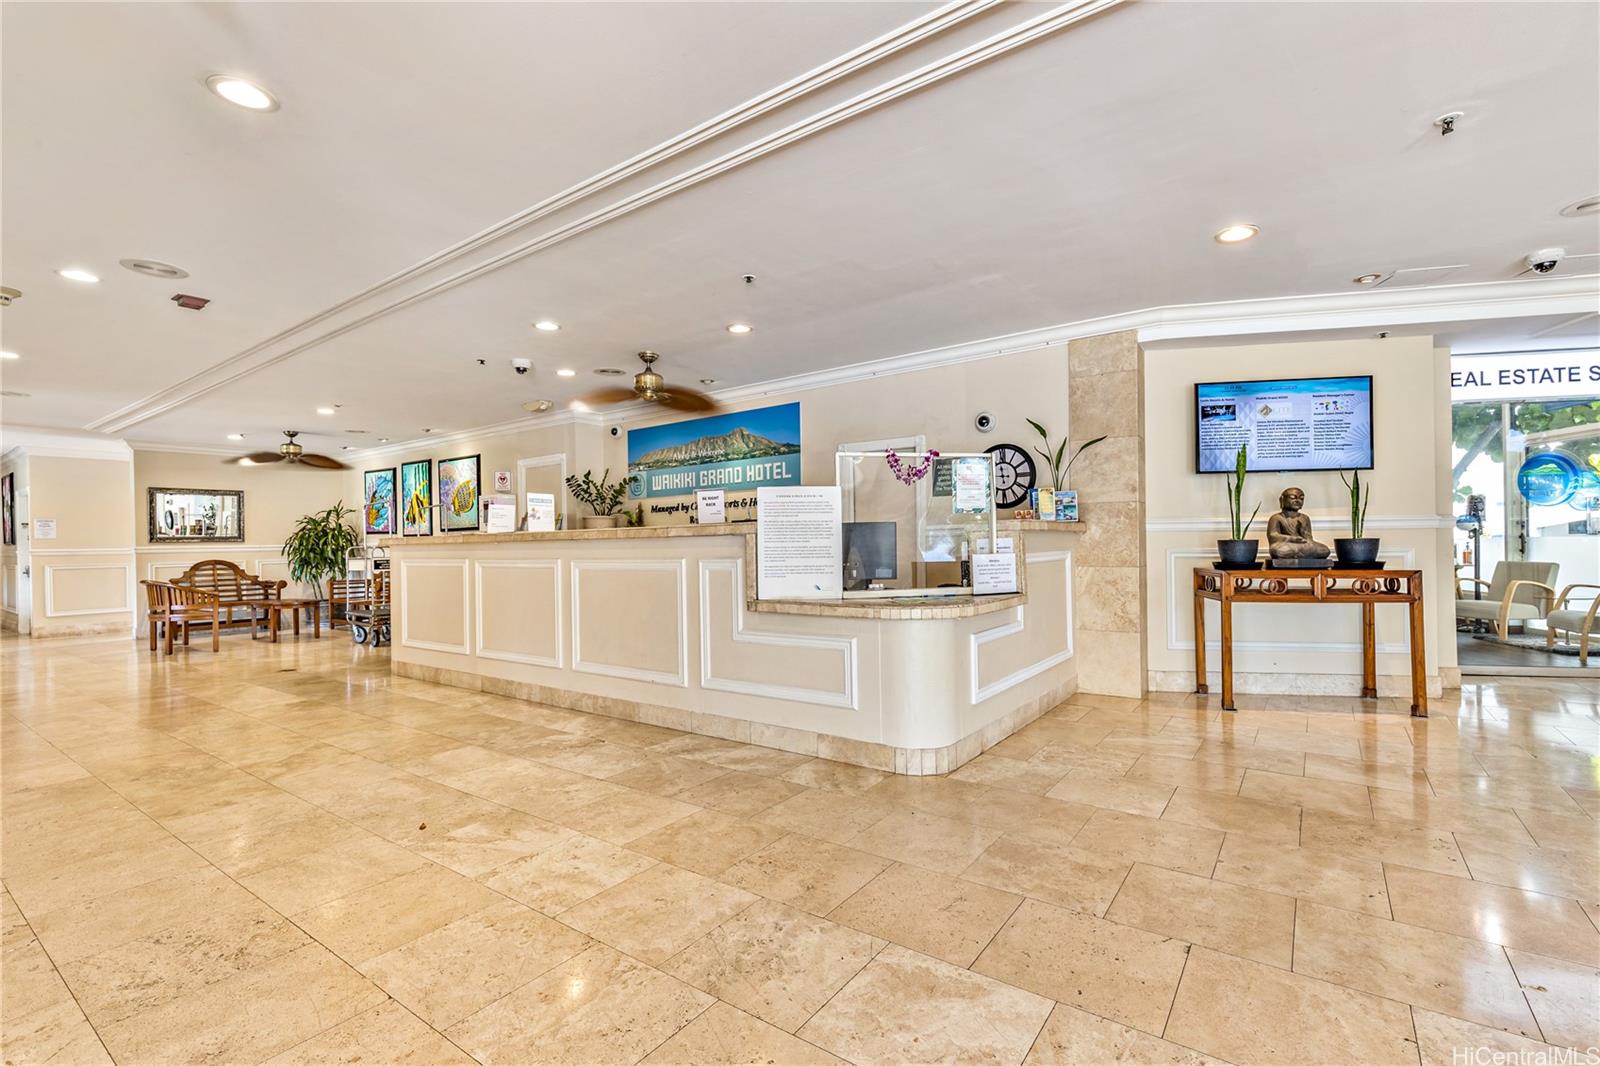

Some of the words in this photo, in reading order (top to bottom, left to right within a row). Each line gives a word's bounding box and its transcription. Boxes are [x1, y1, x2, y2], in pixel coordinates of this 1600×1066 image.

[1451, 371, 1491, 388] EAL
[1498, 366, 1581, 386] ESTATE
[1588, 365, 1600, 382] S
[652, 471, 696, 491] WAIKIKI
[700, 466, 742, 486] GRAND
[746, 461, 792, 481] HOTEL
[651, 502, 679, 515] Managed
[681, 502, 690, 513] by
[724, 499, 740, 509] orts
[740, 498, 748, 507] &
